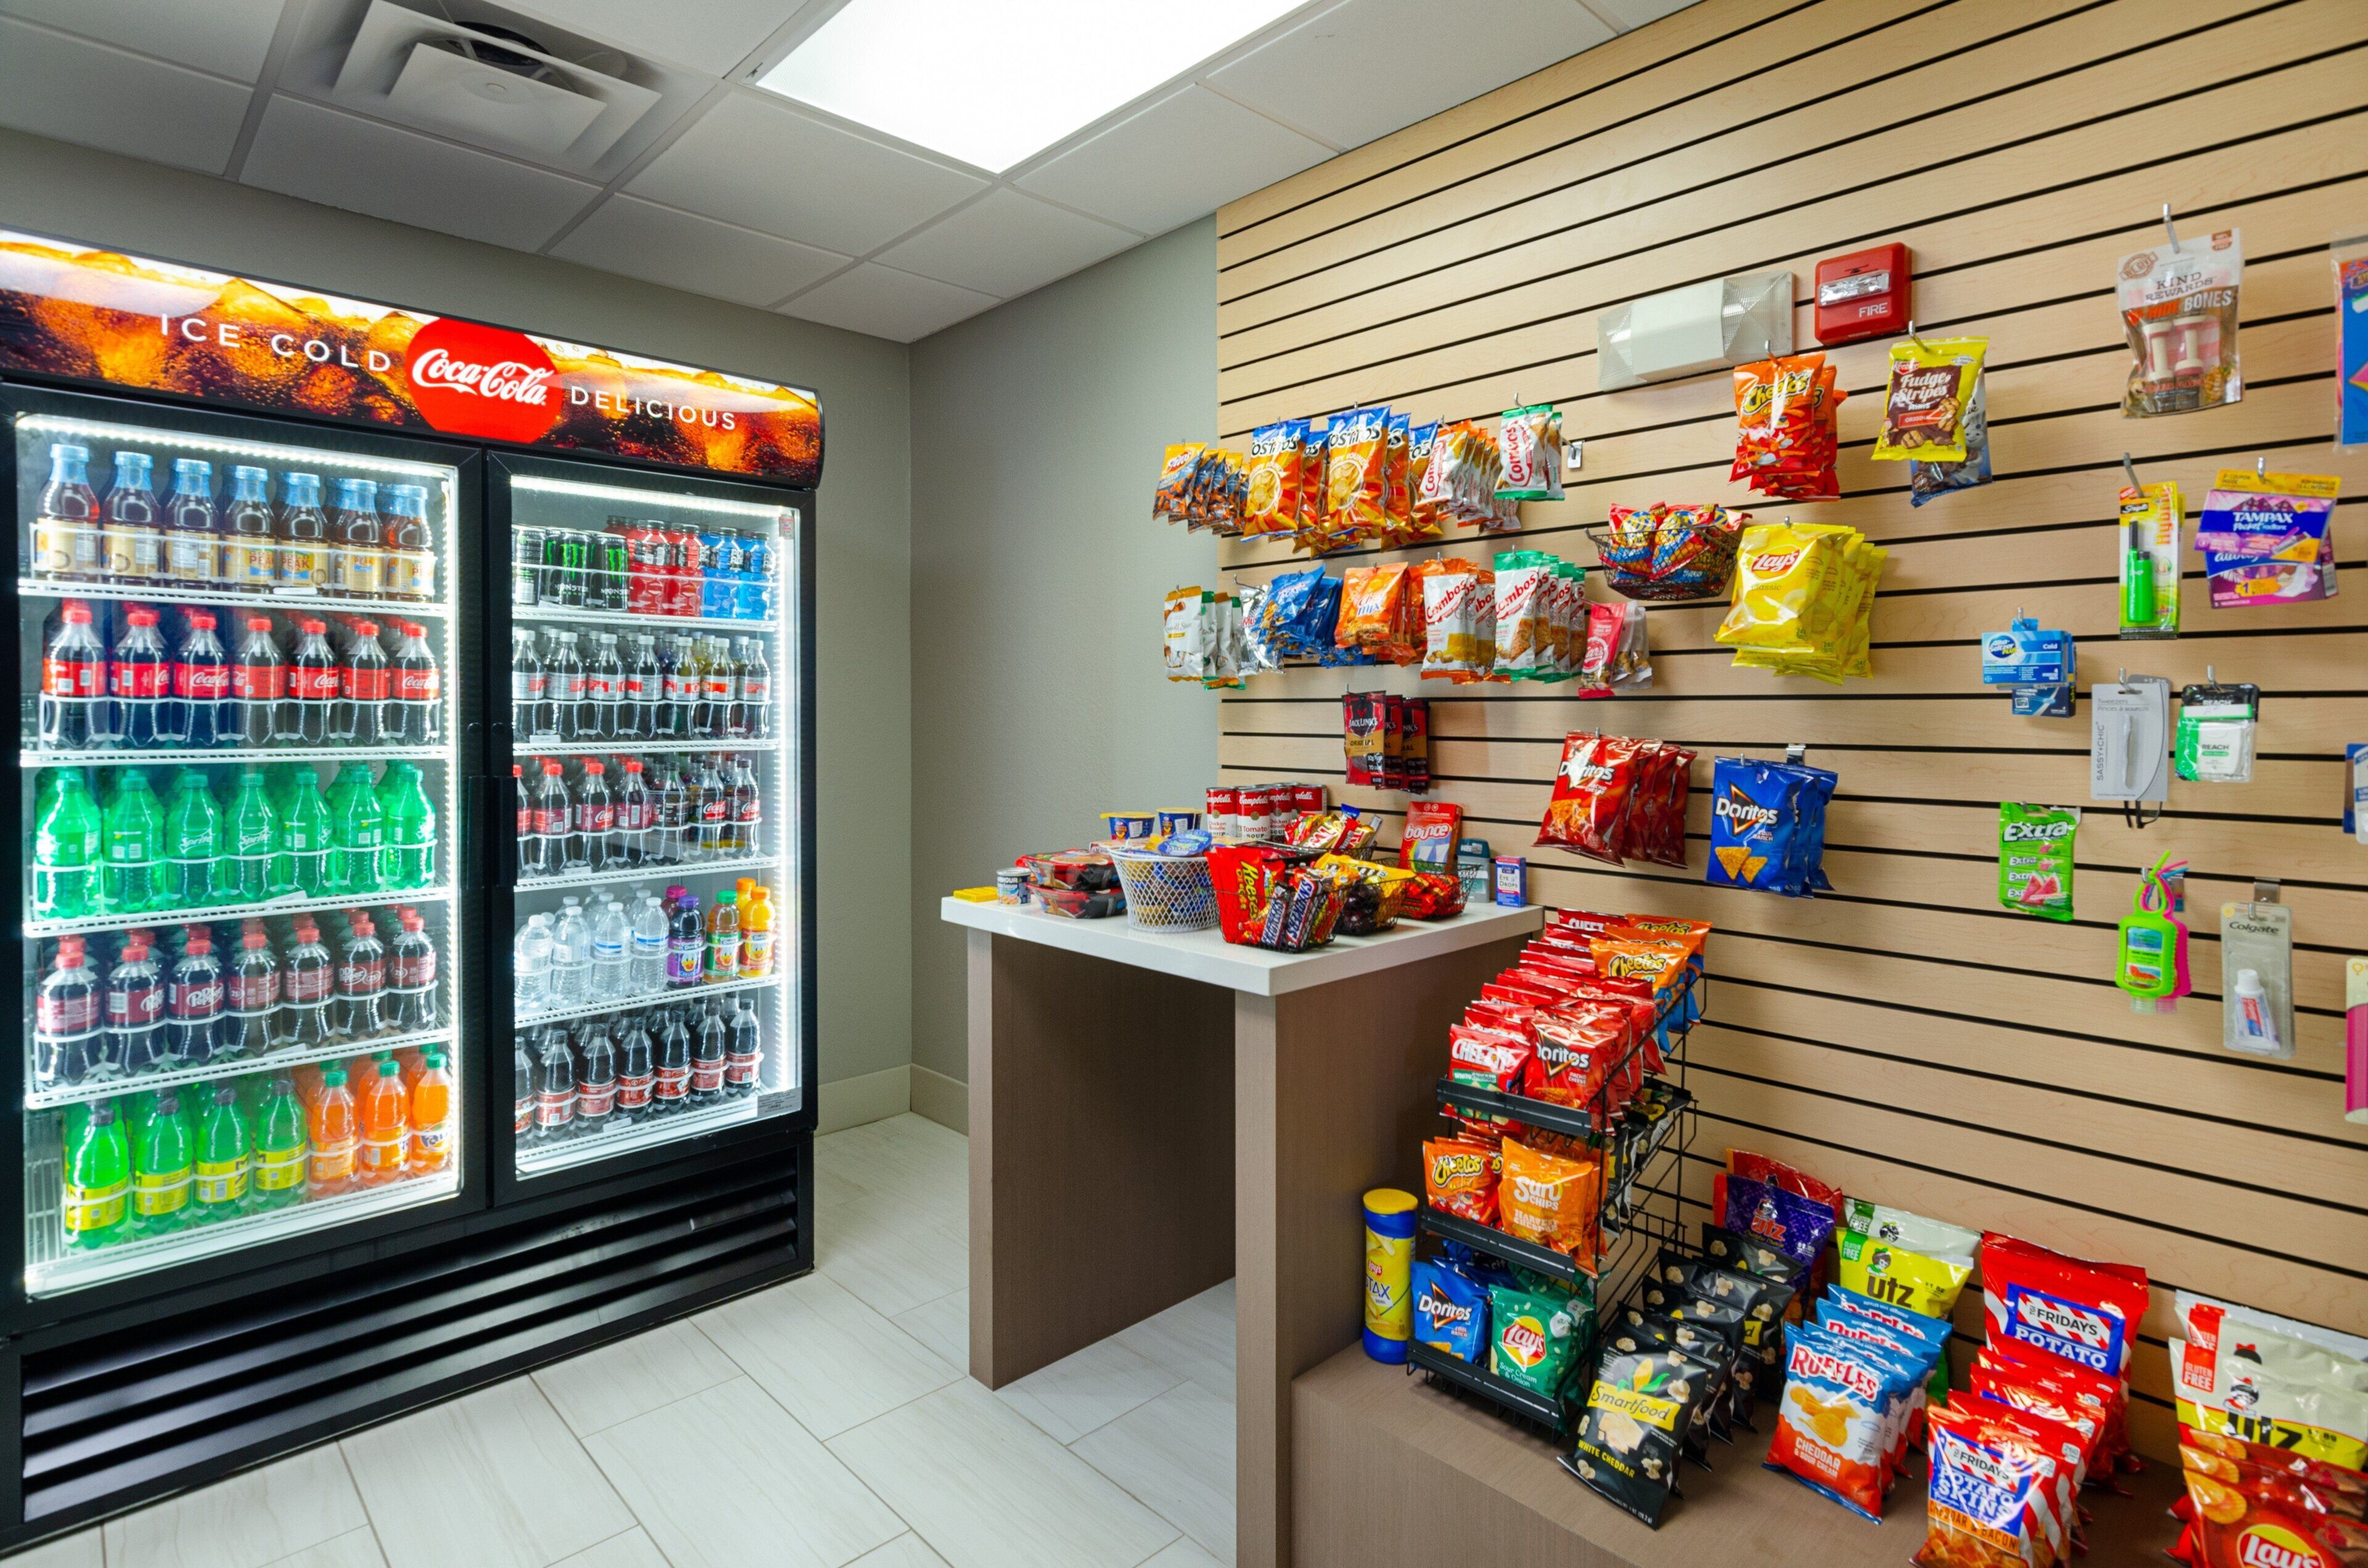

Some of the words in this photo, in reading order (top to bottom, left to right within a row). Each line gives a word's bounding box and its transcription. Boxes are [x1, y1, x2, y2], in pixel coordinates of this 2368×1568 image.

[2145, 277, 2214, 301] REWARDS
[2156, 272, 2202, 290] KIND
[1859, 302, 1888, 318] FIRE
[2184, 290, 2233, 312] BONES
[160, 312, 241, 350] ICE
[269, 332, 392, 374] COLD
[411, 347, 548, 408] Coca-Cola
[1901, 372, 1947, 388] Fudge
[1743, 371, 1811, 414] Cheetos
[1898, 385, 1947, 403] Stripes
[570, 385, 737, 432] DELICIOUS
[2232, 511, 2293, 523] TAMPAX
[1753, 549, 1800, 572] Lay's
[1495, 573, 1536, 615] Combos
[1751, 583, 1782, 591] Classic
[1358, 591, 1383, 607] Che
[1425, 580, 1467, 620] Combos
[1989, 643, 2015, 652] Seltzer
[1558, 761, 1616, 782] Doritos
[1270, 792, 1292, 802] mpbell's
[1714, 797, 1779, 825] Doritos
[1405, 824, 1450, 840] bounce
[2003, 820, 2070, 842] Extra
[2008, 855, 2036, 866] Extra
[1287, 878, 1313, 940] SNICKERS
[2229, 921, 2279, 935] Colgate
[1610, 953, 1667, 977] Cheetos
[1453, 1072, 1473, 1081] WHITE
[1568, 1075, 1587, 1085] CHEESE
[1569, 1071, 1587, 1080] NACHO
[1433, 1155, 1484, 1187] Cheetos
[1513, 1176, 1562, 1204] Sun
[1529, 1196, 1559, 1211] CHIPS
[1751, 1215, 1787, 1242] utz
[1851, 1219, 1870, 1234] FREE
[1843, 1247, 1860, 1262] FREE
[1844, 1241, 1862, 1251] GLUTEN
[1368, 1261, 1383, 1275] Lay's
[1866, 1275, 1915, 1309] utz
[1418, 1295, 1473, 1321] Doritos
[2036, 1307, 2099, 1337] FRIDAYS
[1503, 1324, 1545, 1355] Lay's
[2015, 1326, 2108, 1369] POTATO
[1499, 1361, 1514, 1374] Sour
[1513, 1365, 1537, 1384] Cream
[1510, 1373, 1531, 1387] Onion
[1789, 1345, 1878, 1400] RUFFLES
[2183, 1371, 2213, 1391] FREE
[2185, 1361, 2213, 1378] GLUTEN
[1590, 1384, 1672, 1422] Smartfood
[1577, 1439, 1601, 1460] WHITE
[1601, 1450, 1635, 1479] CHEDDAR
[1795, 1436, 1841, 1470] CHEDDAR
[1799, 1450, 1818, 1468] SOUR
[1816, 1458, 1838, 1479] CREAM
[1959, 1450, 2010, 1480] FRIDAYS
[1938, 1466, 2015, 1505] POTATO
[1936, 1479, 2013, 1524] SKINS
[1981, 1525, 2016, 1550] BACON
